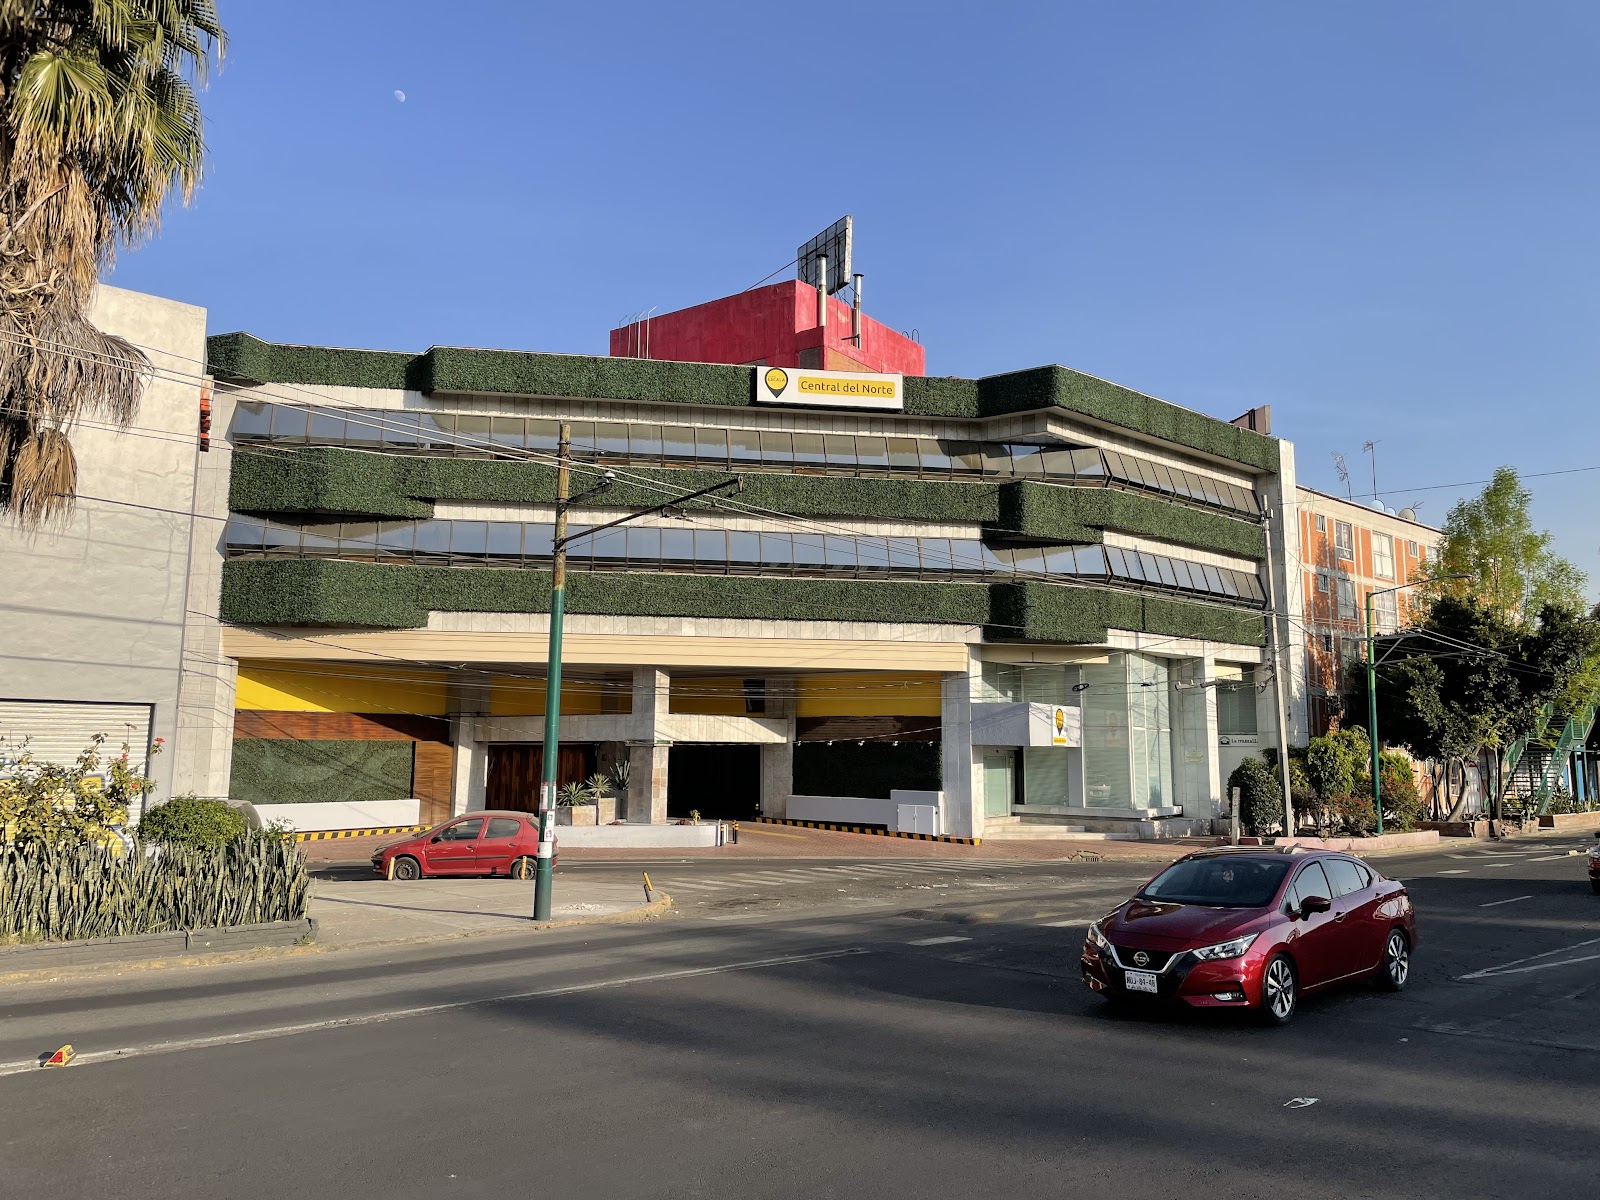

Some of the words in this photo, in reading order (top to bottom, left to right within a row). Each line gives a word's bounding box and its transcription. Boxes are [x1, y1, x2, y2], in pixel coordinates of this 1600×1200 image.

[800, 380, 840, 392] Central
[843, 382, 859, 393] del
[862, 384, 893, 395] Norte
